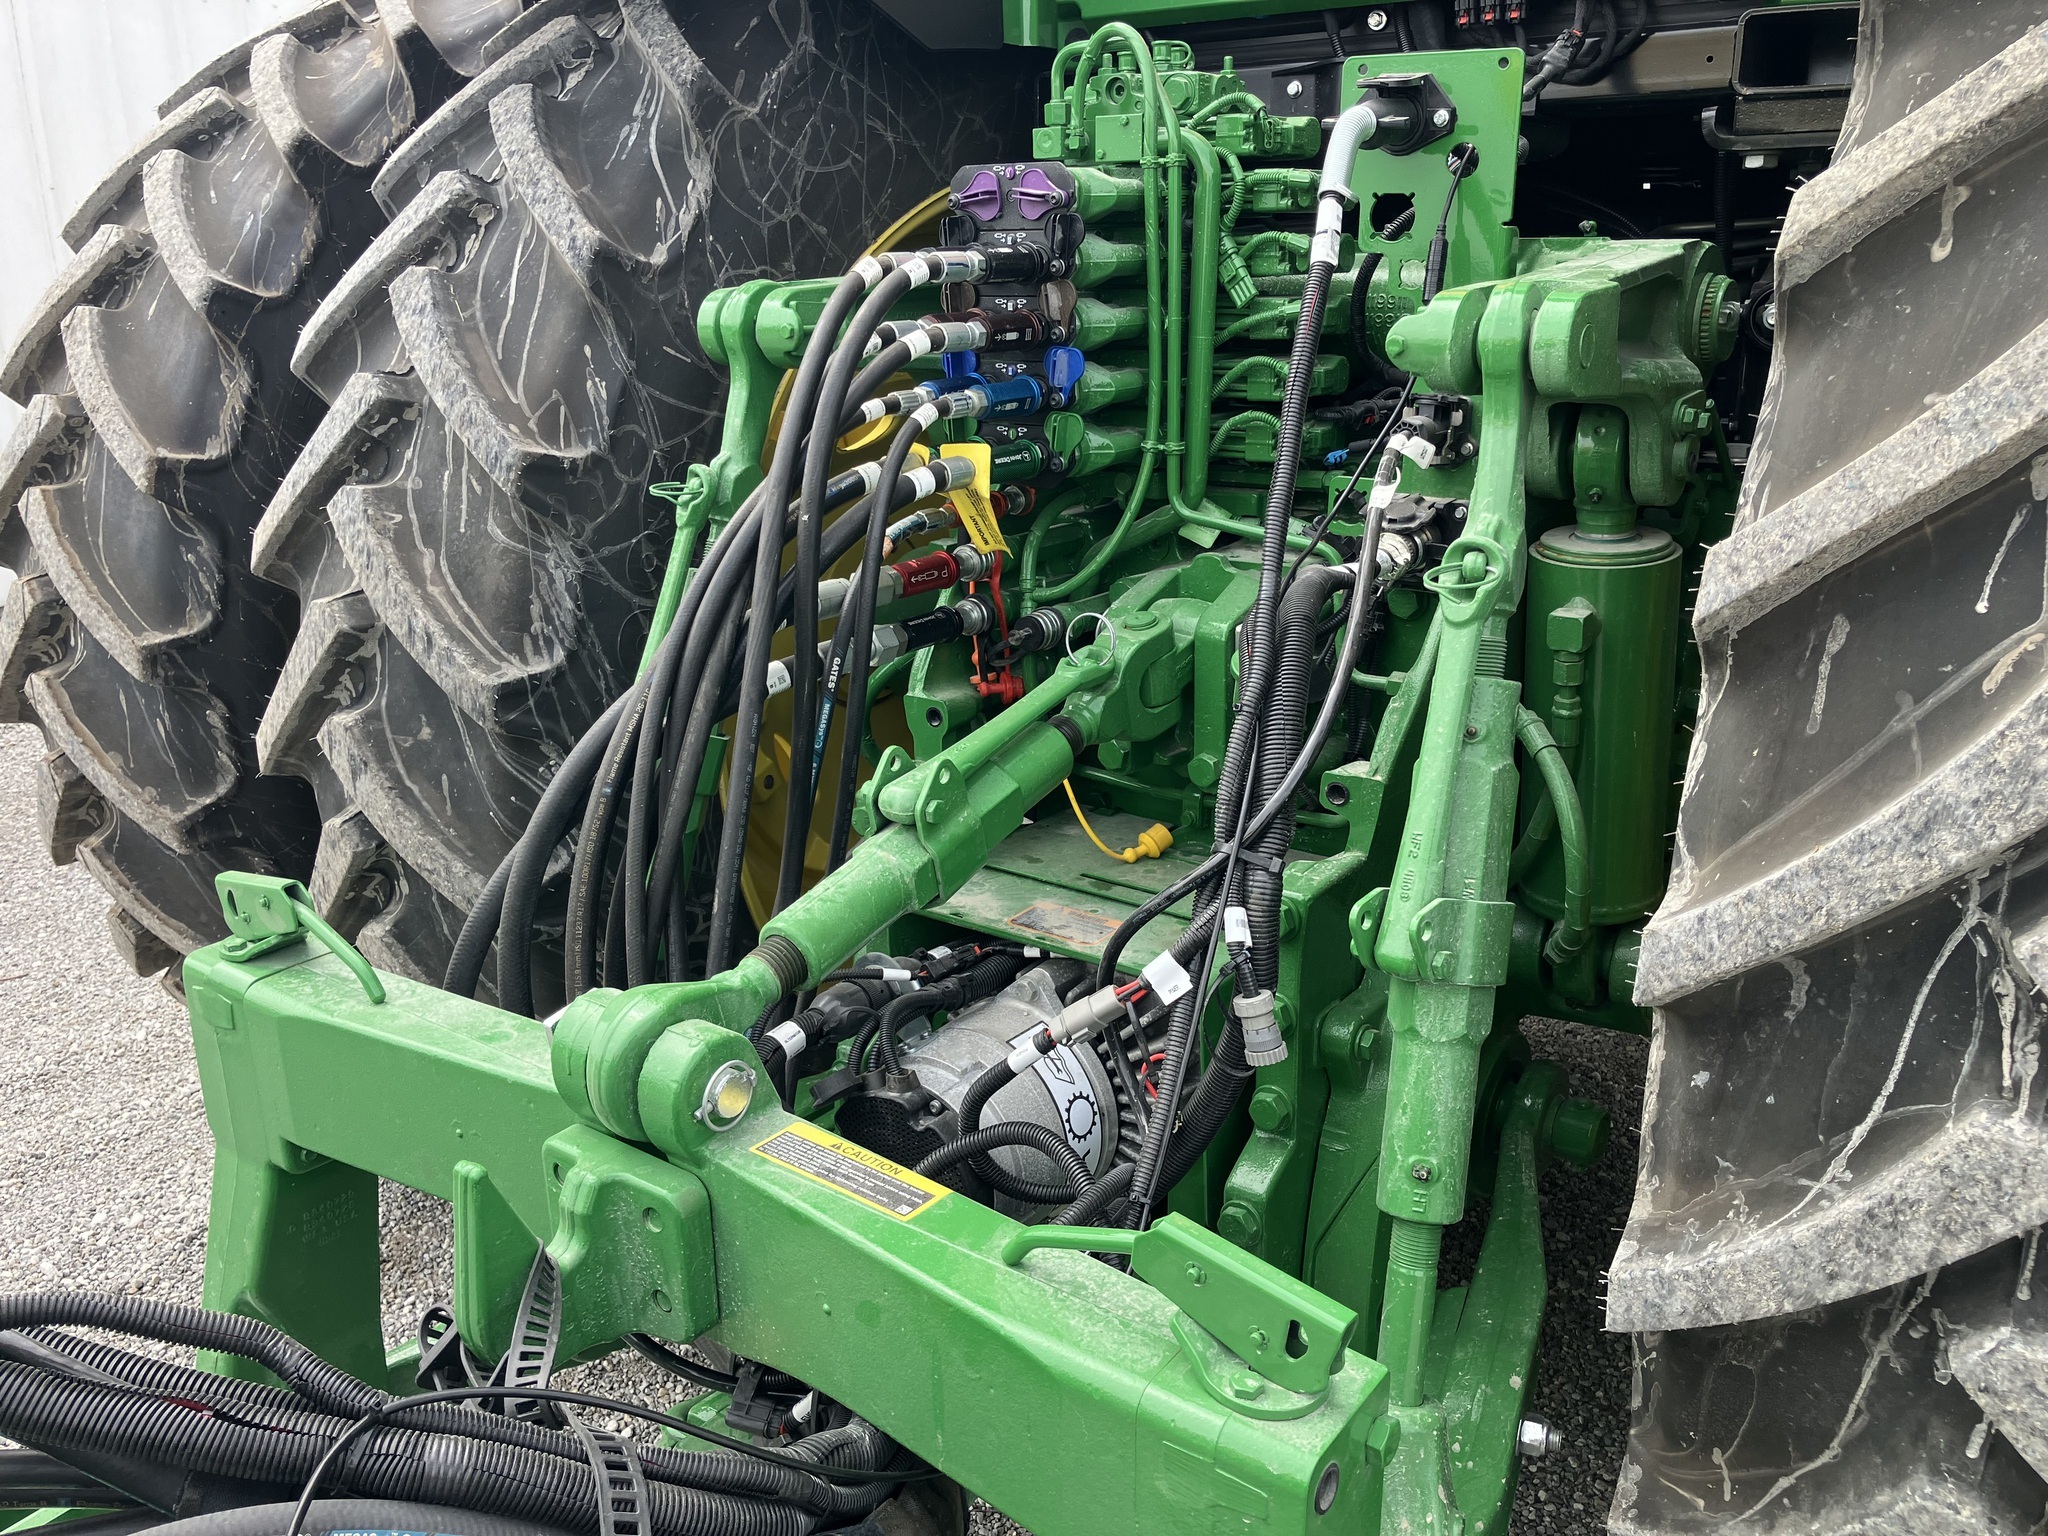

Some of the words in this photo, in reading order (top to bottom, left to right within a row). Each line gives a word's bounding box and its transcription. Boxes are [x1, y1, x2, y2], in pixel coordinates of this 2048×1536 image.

[969, 515, 990, 547] IMPORTANT
[941, 565, 949, 578] P
[828, 657, 841, 690] GATES
[606, 761, 619, 783] Flame
[613, 731, 631, 762] Resistant
[626, 712, 640, 732] MSHA
[595, 802, 605, 818] Type
[589, 818, 600, 840] 18752
[586, 840, 595, 853] ISO
[578, 884, 586, 896] SAE
[576, 902, 584, 916] R17
[841, 1145, 903, 1176] CAUTION
